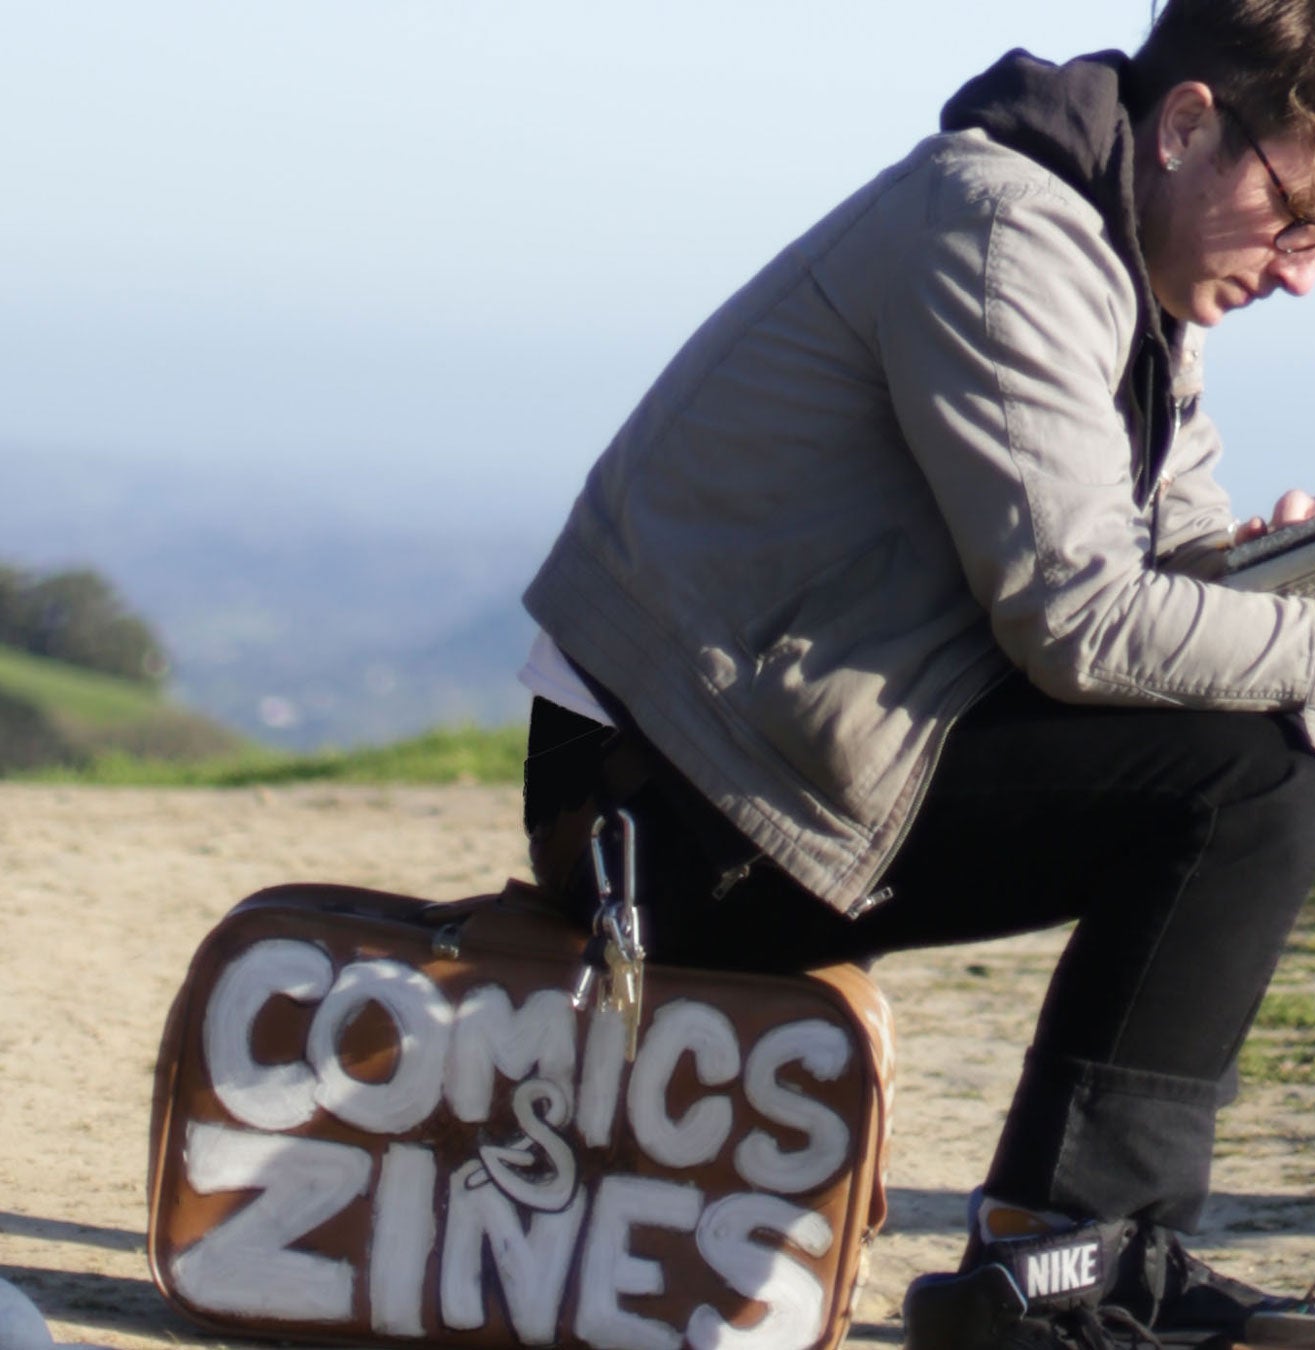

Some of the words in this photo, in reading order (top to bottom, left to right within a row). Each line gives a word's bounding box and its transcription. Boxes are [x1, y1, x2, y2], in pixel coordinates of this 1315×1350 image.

[205, 938, 851, 1193] COMICS
[172, 1122, 833, 1350] ZINES
[1027, 1243, 1098, 1298] NIKE
